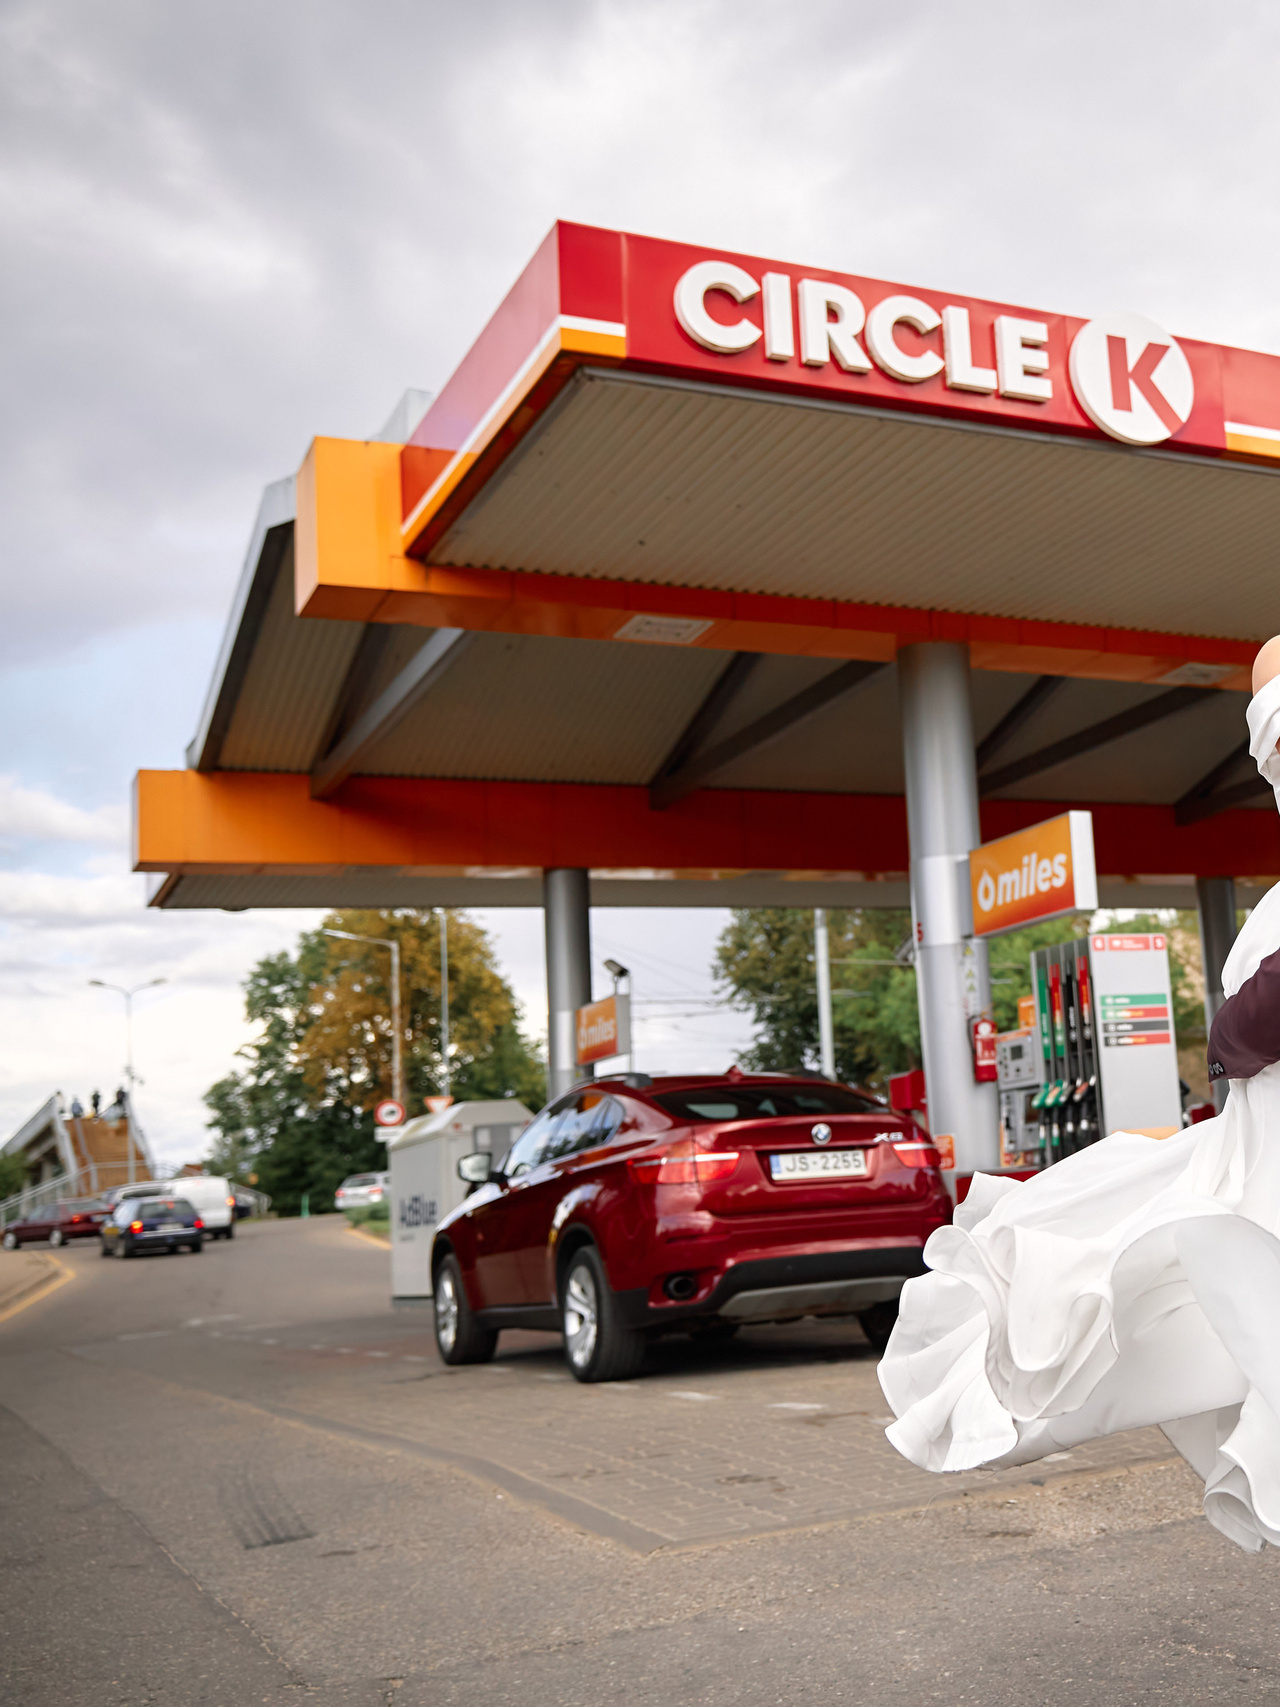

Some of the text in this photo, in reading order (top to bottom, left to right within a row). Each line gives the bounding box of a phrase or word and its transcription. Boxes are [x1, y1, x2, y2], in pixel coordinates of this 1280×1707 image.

[674, 260, 1189, 437] CIRCLE K
[998, 853, 1067, 905] miles
[786, 1152, 862, 1172] JS-2255
